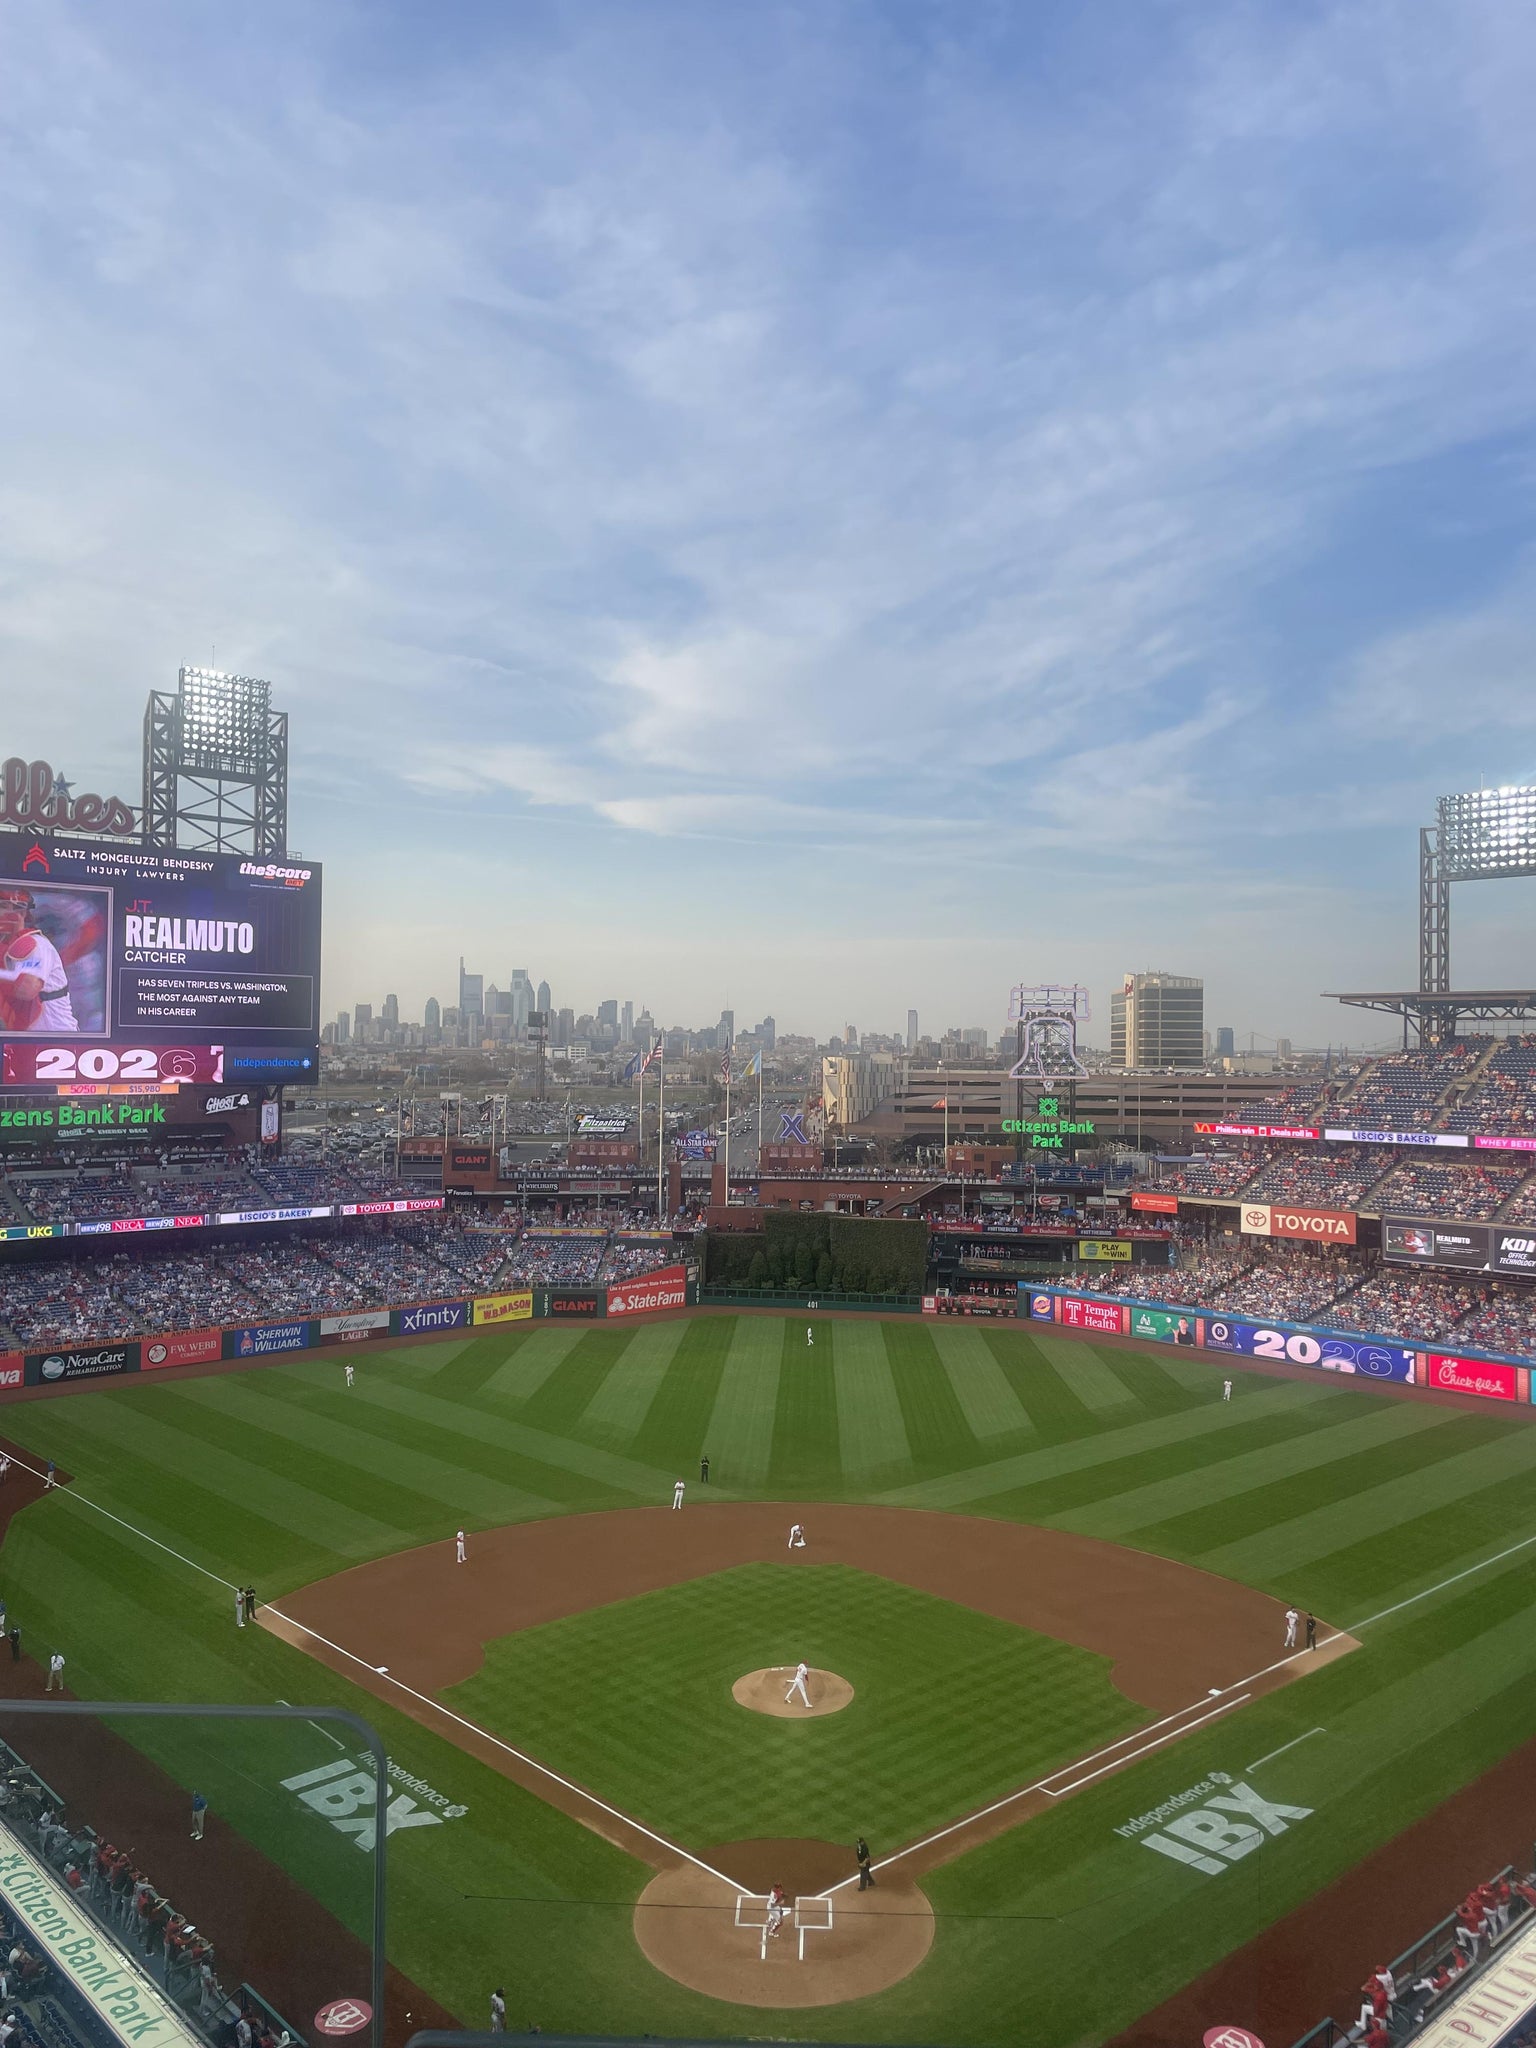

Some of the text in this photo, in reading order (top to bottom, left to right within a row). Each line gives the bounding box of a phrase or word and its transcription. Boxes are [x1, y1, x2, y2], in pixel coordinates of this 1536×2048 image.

[0, 757, 135, 836] llies
[54, 848, 214, 871] SALTZ MONGELUZZI BENDESKY
[86, 865, 185, 882] INJURY LAWYERS
[239, 862, 312, 880] theScore
[125, 899, 153, 914] J.T.
[125, 914, 254, 954] REALMUTO
[124, 950, 186, 964] CATCHER
[138, 978, 288, 993] HAS SEVEN TRIPLES VS. WASHINGTON,
[138, 992, 260, 1005] THE MOST AGAINST ANY TEAM
[137, 1007, 197, 1017] IN HIS CAREER
[35, 1048, 197, 1079] 2026
[233, 1057, 300, 1069] Independence
[129, 1085, 161, 1094] $15,980
[205, 1093, 241, 1114] GHOST
[58, 1103, 115, 1126] Bank
[118, 1103, 166, 1125] Park
[579, 1114, 627, 1127] Fitzpatrick
[1001, 1119, 1095, 1134] Citizens Bank
[1215, 1125, 1241, 1134] Phillies
[1270, 1128, 1291, 1136] Deals
[1291, 1129, 1304, 1137] roll
[1305, 1129, 1313, 1137] in
[1032, 1134, 1063, 1148] Park
[1351, 1131, 1438, 1144] LISCIO'S BAKERY
[1480, 1139, 1507, 1147] WHEY
[455, 1156, 487, 1164] GIANT
[359, 1199, 440, 1213] TOYOTA TOYOTA
[239, 1208, 313, 1221] LISCIO'S BAKERY
[115, 1220, 144, 1231] NECA
[177, 1216, 203, 1226] NECA
[1275, 1214, 1350, 1236] TOYOTA
[27, 1226, 53, 1238] UKG
[1436, 1234, 1471, 1245] REALMUTO
[1101, 1243, 1120, 1251] PLAY
[1499, 1257, 1536, 1267] TECHNOLOGY
[1507, 1252, 1528, 1260] OFFICE
[552, 1301, 597, 1311] GIANT
[807, 1300, 818, 1309] 401
[1084, 1303, 1118, 1319] Temple
[404, 1306, 461, 1331] xfinity
[1085, 1316, 1116, 1330] Health
[18, 1346, 63, 1356] ASPLUNDH
[72, 1340, 114, 1349] ASPLUNDH
[171, 1328, 211, 1337] ASPLUNDH
[218, 1322, 257, 1331] ASPLUNDH
[262, 1316, 300, 1326] ASPLUNDH
[255, 1326, 301, 1340] SHERWIN
[341, 1330, 369, 1341] LAGER
[190, 1340, 217, 1351] WEBB
[66, 1351, 125, 1369] NovaCare
[1253, 1330, 1393, 1377] 2026
[66, 1363, 123, 1377] REHABILITATION
[1439, 1362, 1505, 1393] Chick-fil-A
[279, 1758, 444, 1853] IBX
[1112, 1779, 1215, 1838] Independence
[1140, 1781, 1315, 1876] IBX
[3, 1870, 166, 2041] Citizens Bank Park
